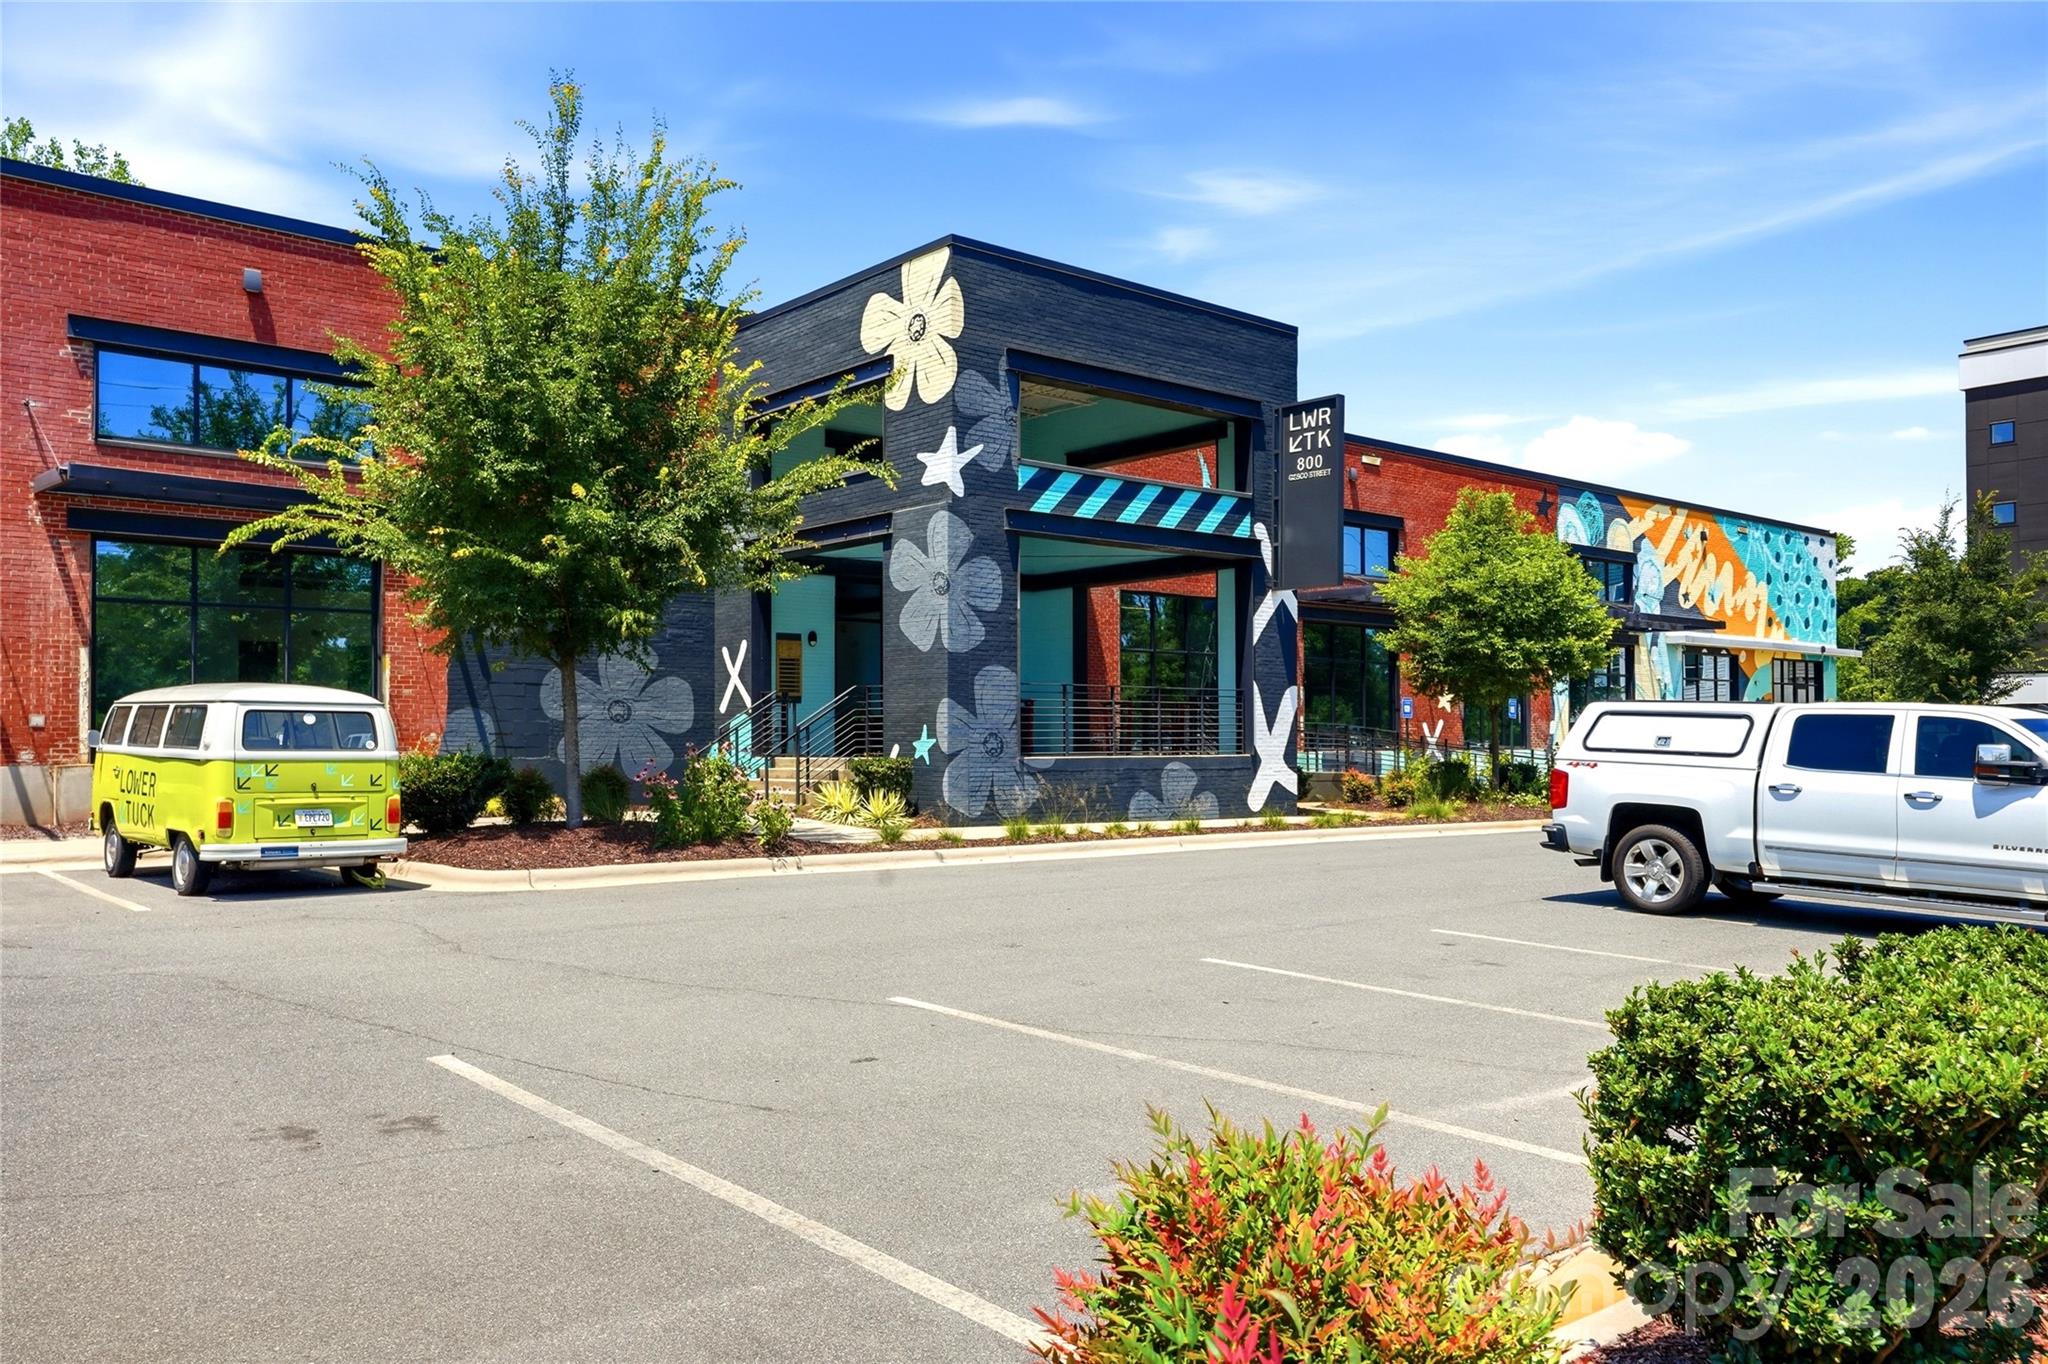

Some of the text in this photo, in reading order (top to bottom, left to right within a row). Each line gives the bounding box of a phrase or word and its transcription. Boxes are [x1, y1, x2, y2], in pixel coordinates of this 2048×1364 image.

[1289, 407, 1331, 431] LWR
[1297, 454, 1323, 471] 800
[1309, 468, 1332, 478] STREET
[120, 769, 157, 797] LOWER
[126, 800, 155, 829] TUCK
